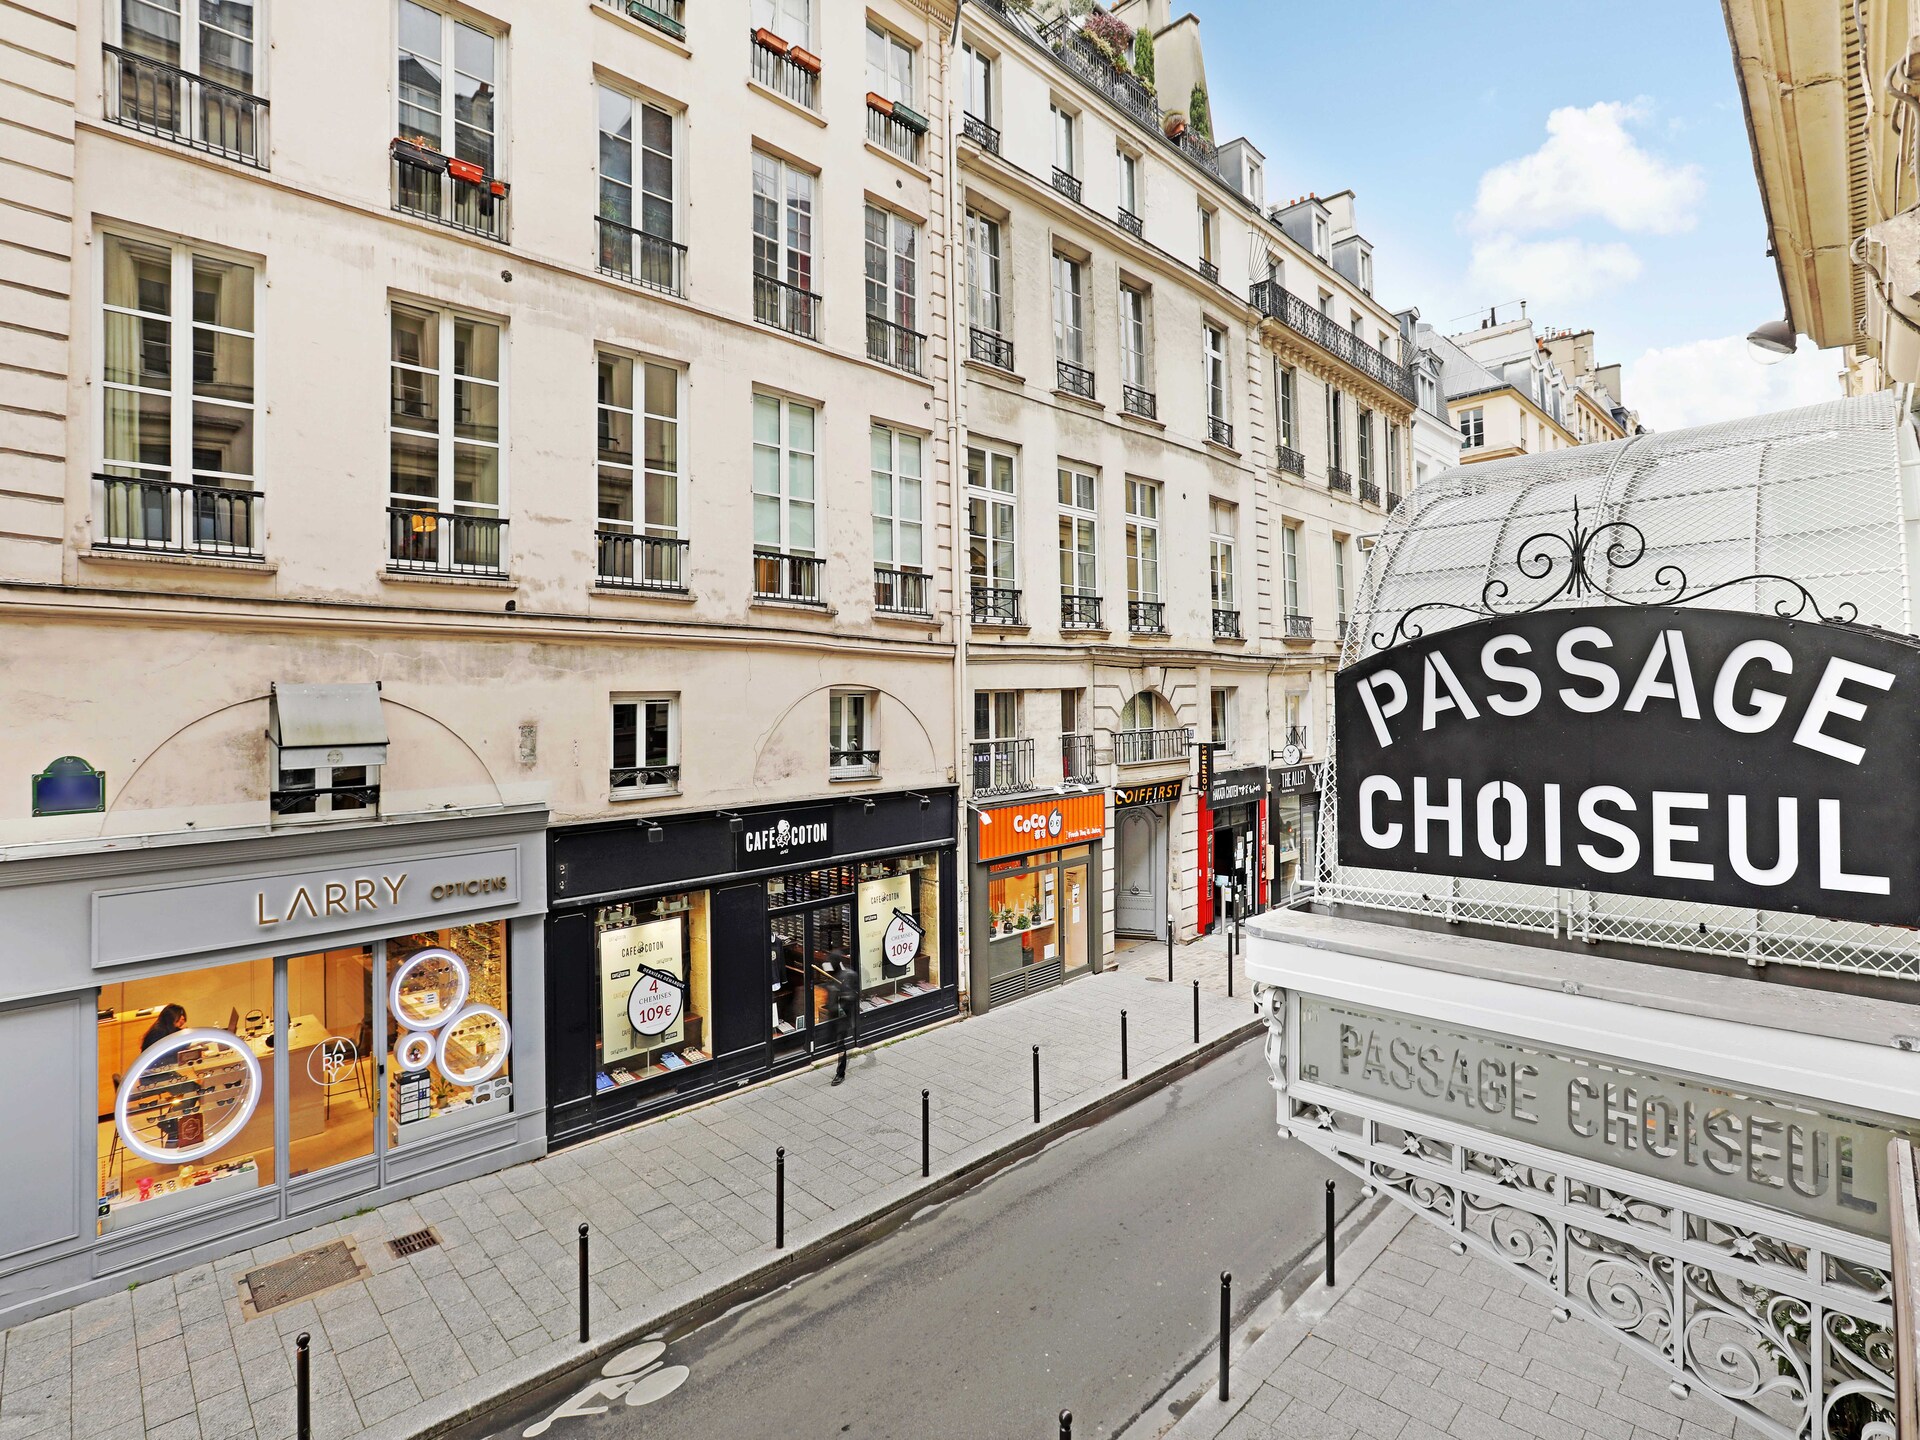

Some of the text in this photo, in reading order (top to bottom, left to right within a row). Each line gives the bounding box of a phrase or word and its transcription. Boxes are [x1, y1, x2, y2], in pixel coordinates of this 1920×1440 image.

[1356, 626, 1897, 765] PASSAGE
[1281, 770, 1307, 788] THE ALLEY
[745, 822, 827, 852] CAFÉ COTON
[1358, 774, 1891, 896] CHOISEUL
[258, 874, 507, 926] LARRY OPTICIENS
[898, 921, 904, 933] 4
[645, 941, 664, 953] COTON
[891, 942, 913, 957] 109€
[649, 979, 658, 993] 4
[638, 992, 672, 1005] CHEMISES
[639, 1004, 672, 1024] 109€
[1339, 1022, 1878, 1215] PASSAGE CHOISEUL
